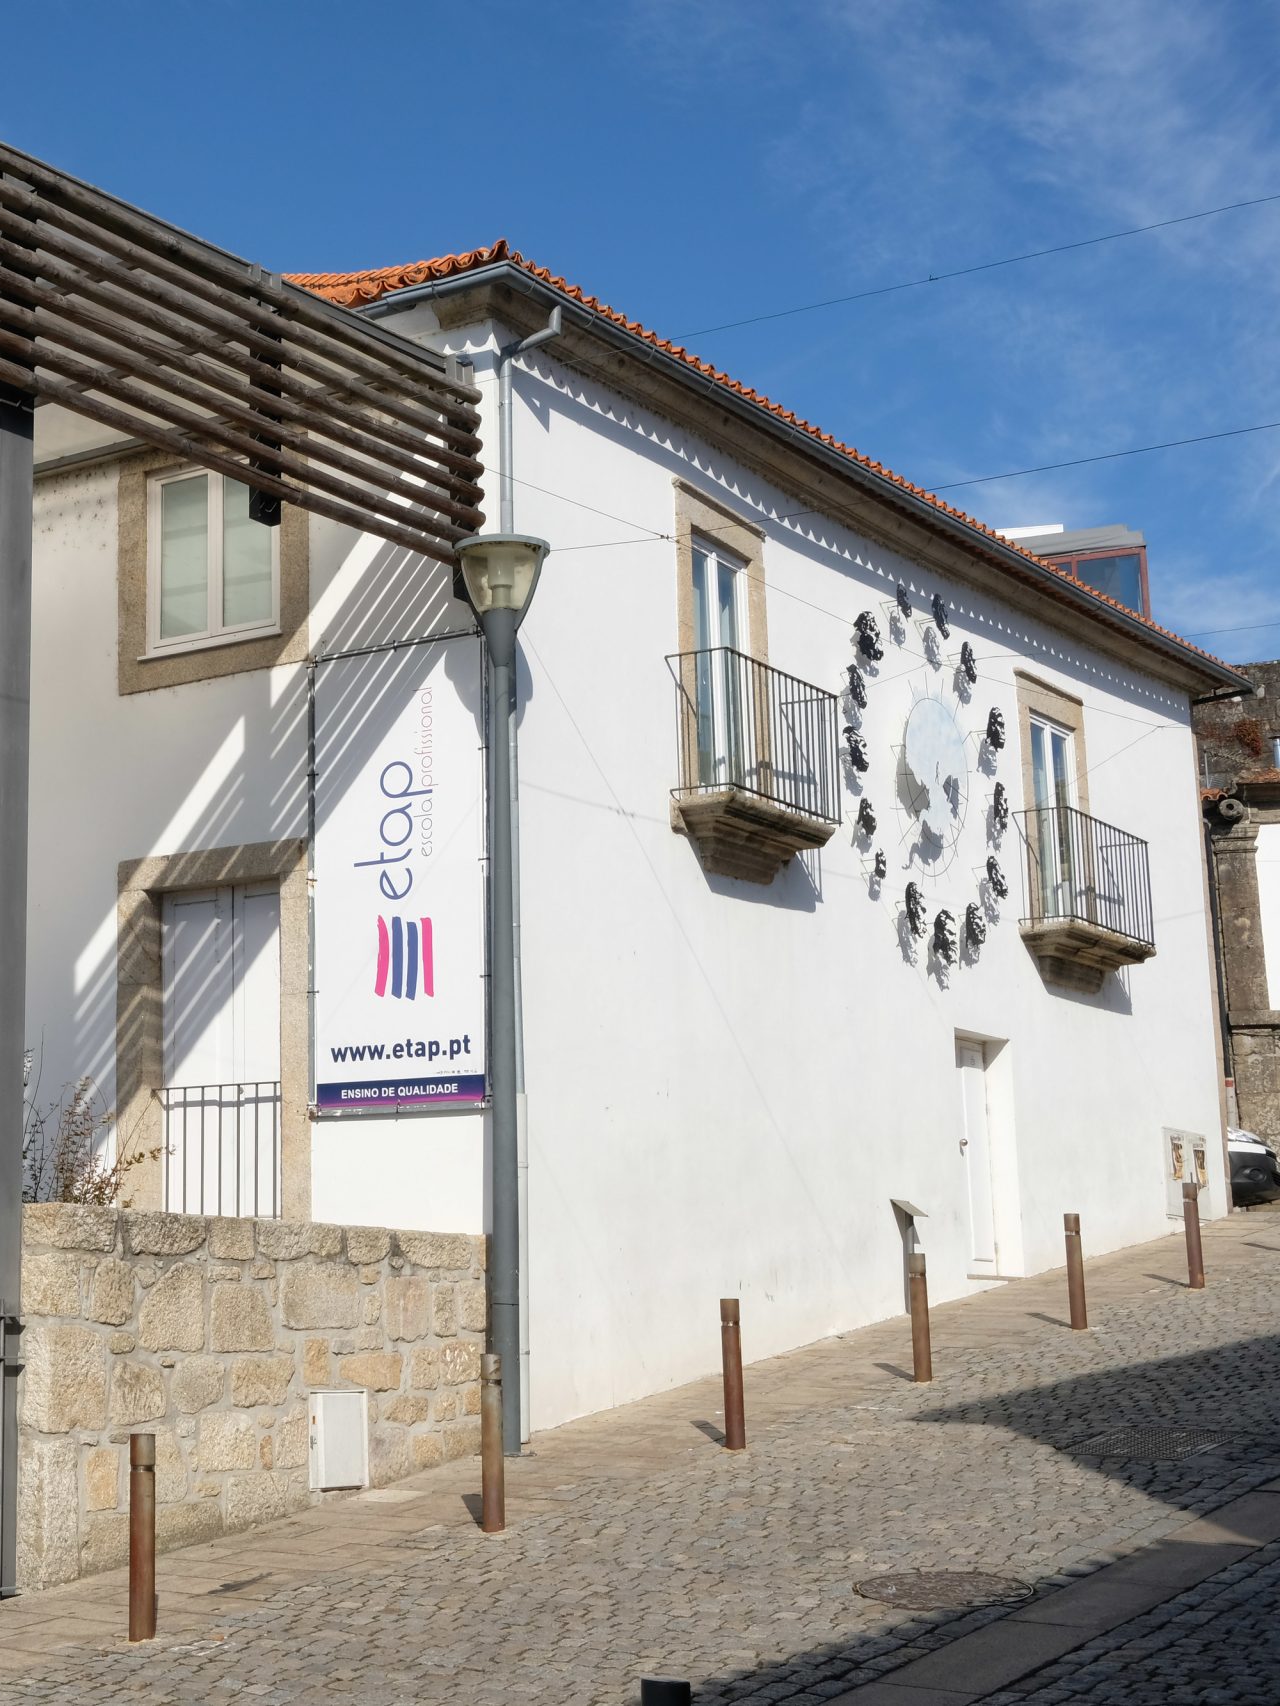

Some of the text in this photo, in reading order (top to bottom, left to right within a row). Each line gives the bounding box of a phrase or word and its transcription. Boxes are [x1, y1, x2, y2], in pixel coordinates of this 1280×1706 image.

[412, 686, 439, 857] escola profissional
[353, 760, 433, 900] etap
[330, 1034, 472, 1063] www.etap.pt
[341, 1083, 459, 1099] ENSINO DE QUALIDADE
